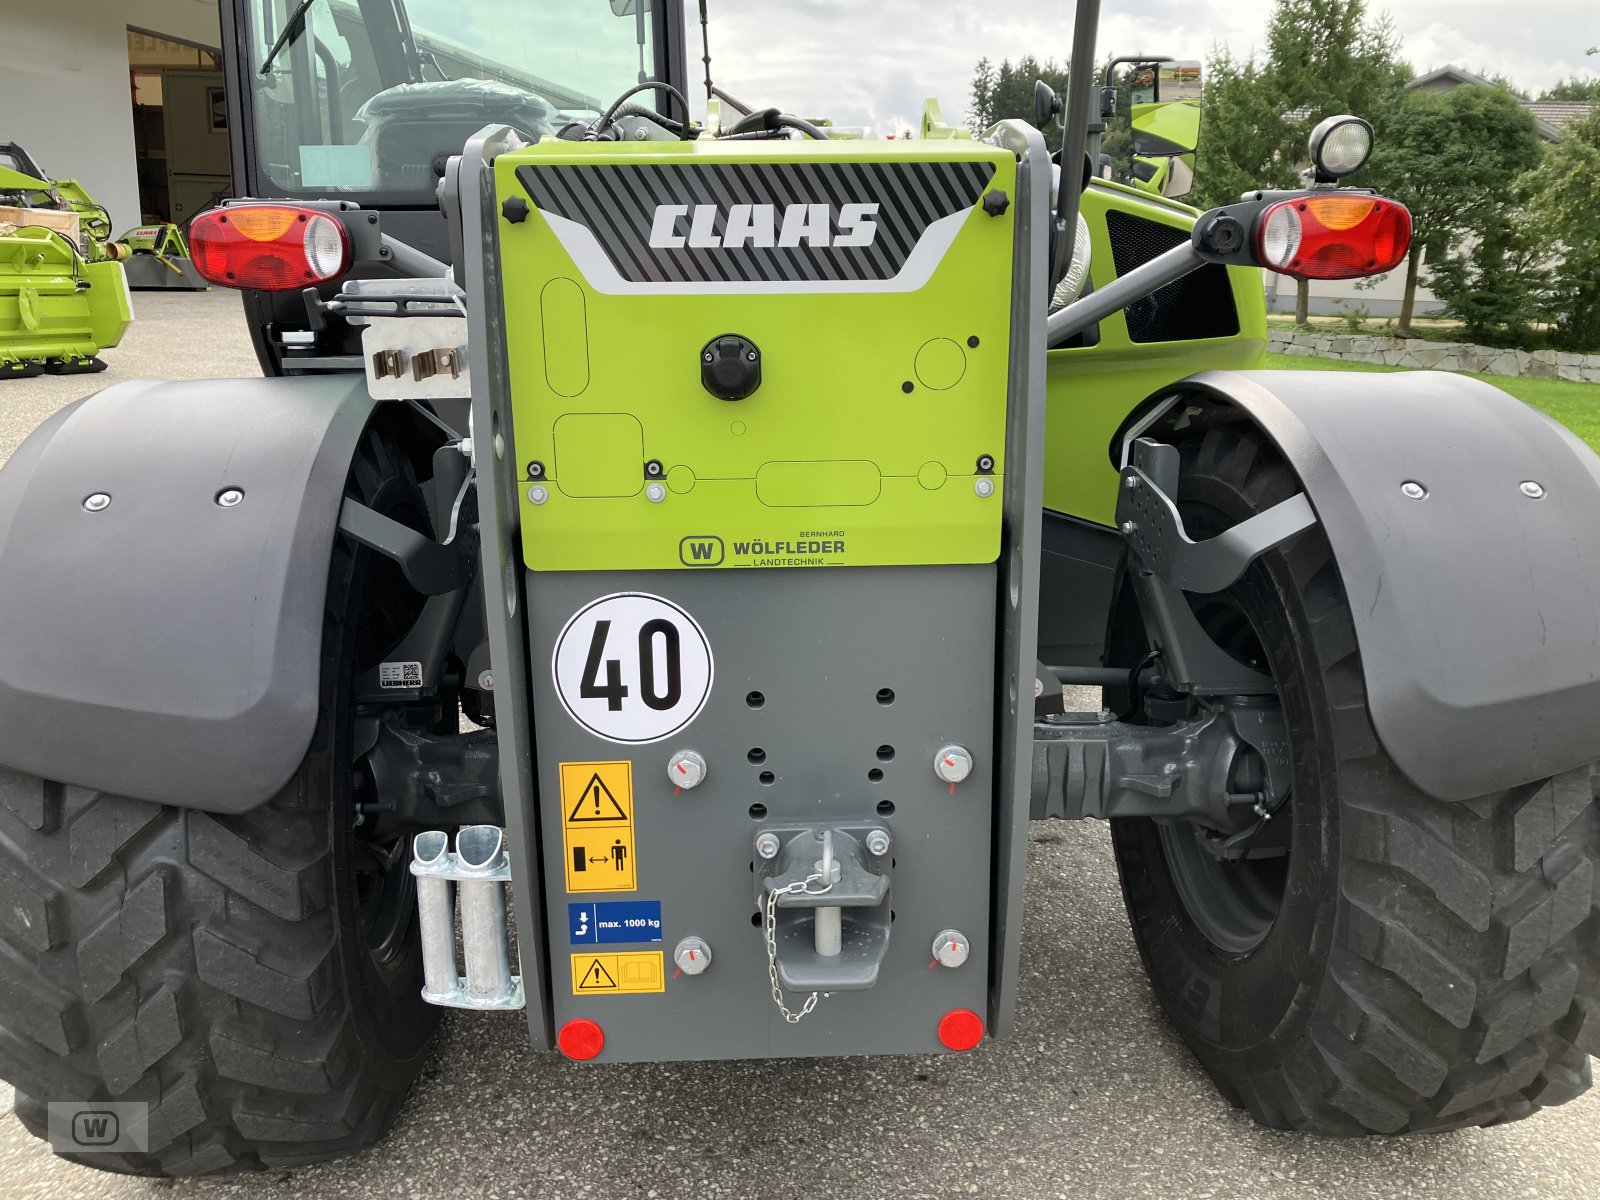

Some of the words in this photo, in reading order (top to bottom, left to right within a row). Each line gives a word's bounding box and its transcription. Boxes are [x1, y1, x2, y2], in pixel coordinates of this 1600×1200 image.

[649, 203, 880, 248] CLAAS
[690, 543, 713, 559] W
[733, 539, 845, 554] WÖLFLEDER
[753, 558, 824, 566] LANDTECHNIK
[580, 618, 682, 711] 40
[624, 919, 646, 927] 1000
[648, 918, 660, 928] kg
